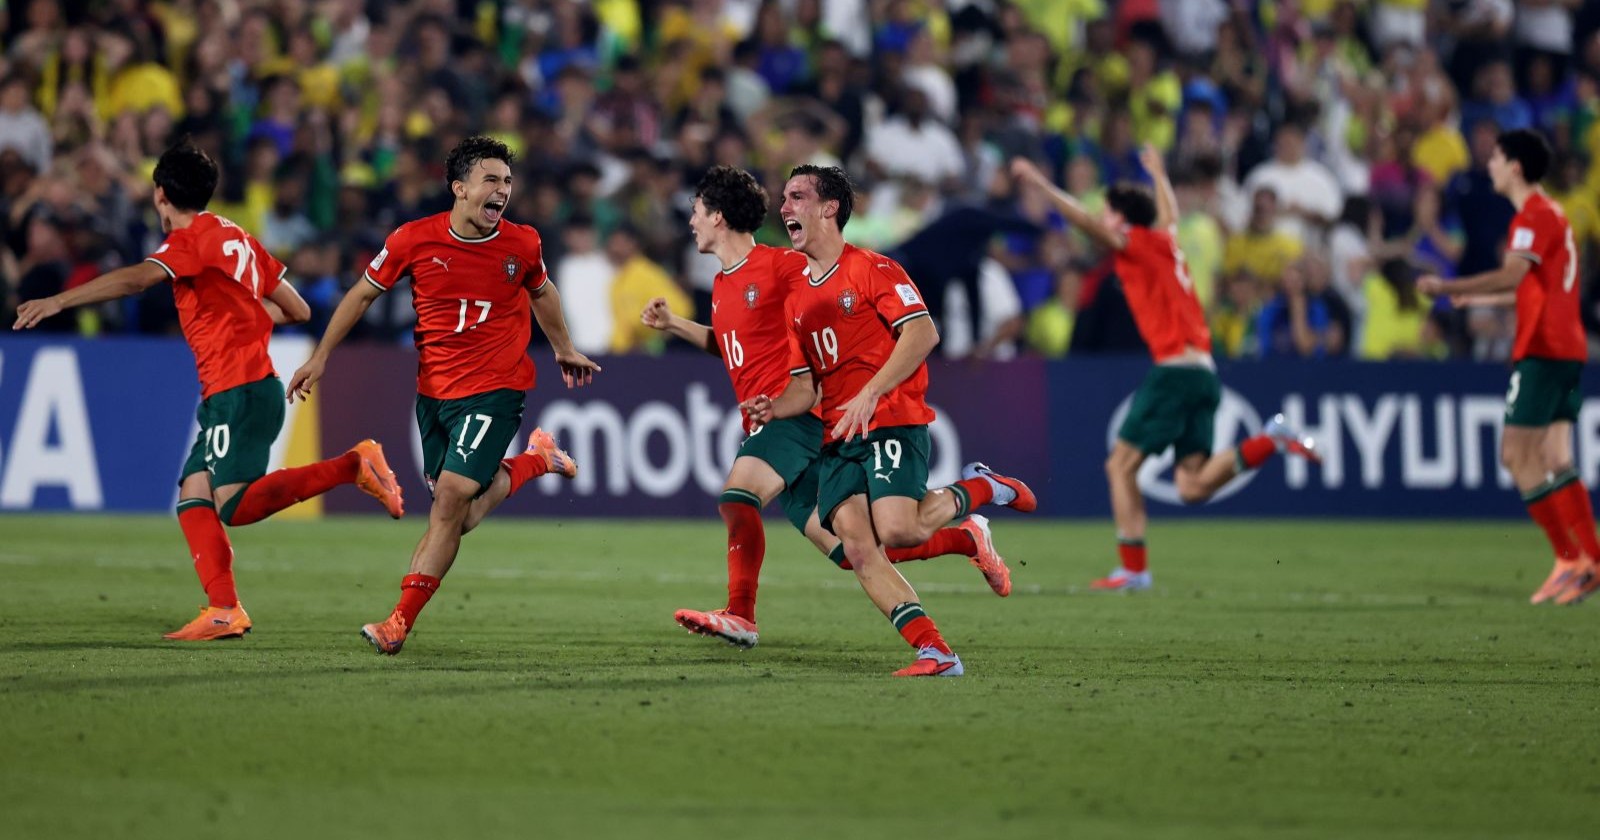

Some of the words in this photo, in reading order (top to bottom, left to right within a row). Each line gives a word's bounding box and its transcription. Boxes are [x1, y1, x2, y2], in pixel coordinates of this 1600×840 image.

[453, 298, 492, 333] 17
[722, 329, 744, 370] 16
[811, 326, 839, 370] 19
[456, 413, 493, 450] 17
[871, 439, 902, 471] 19
